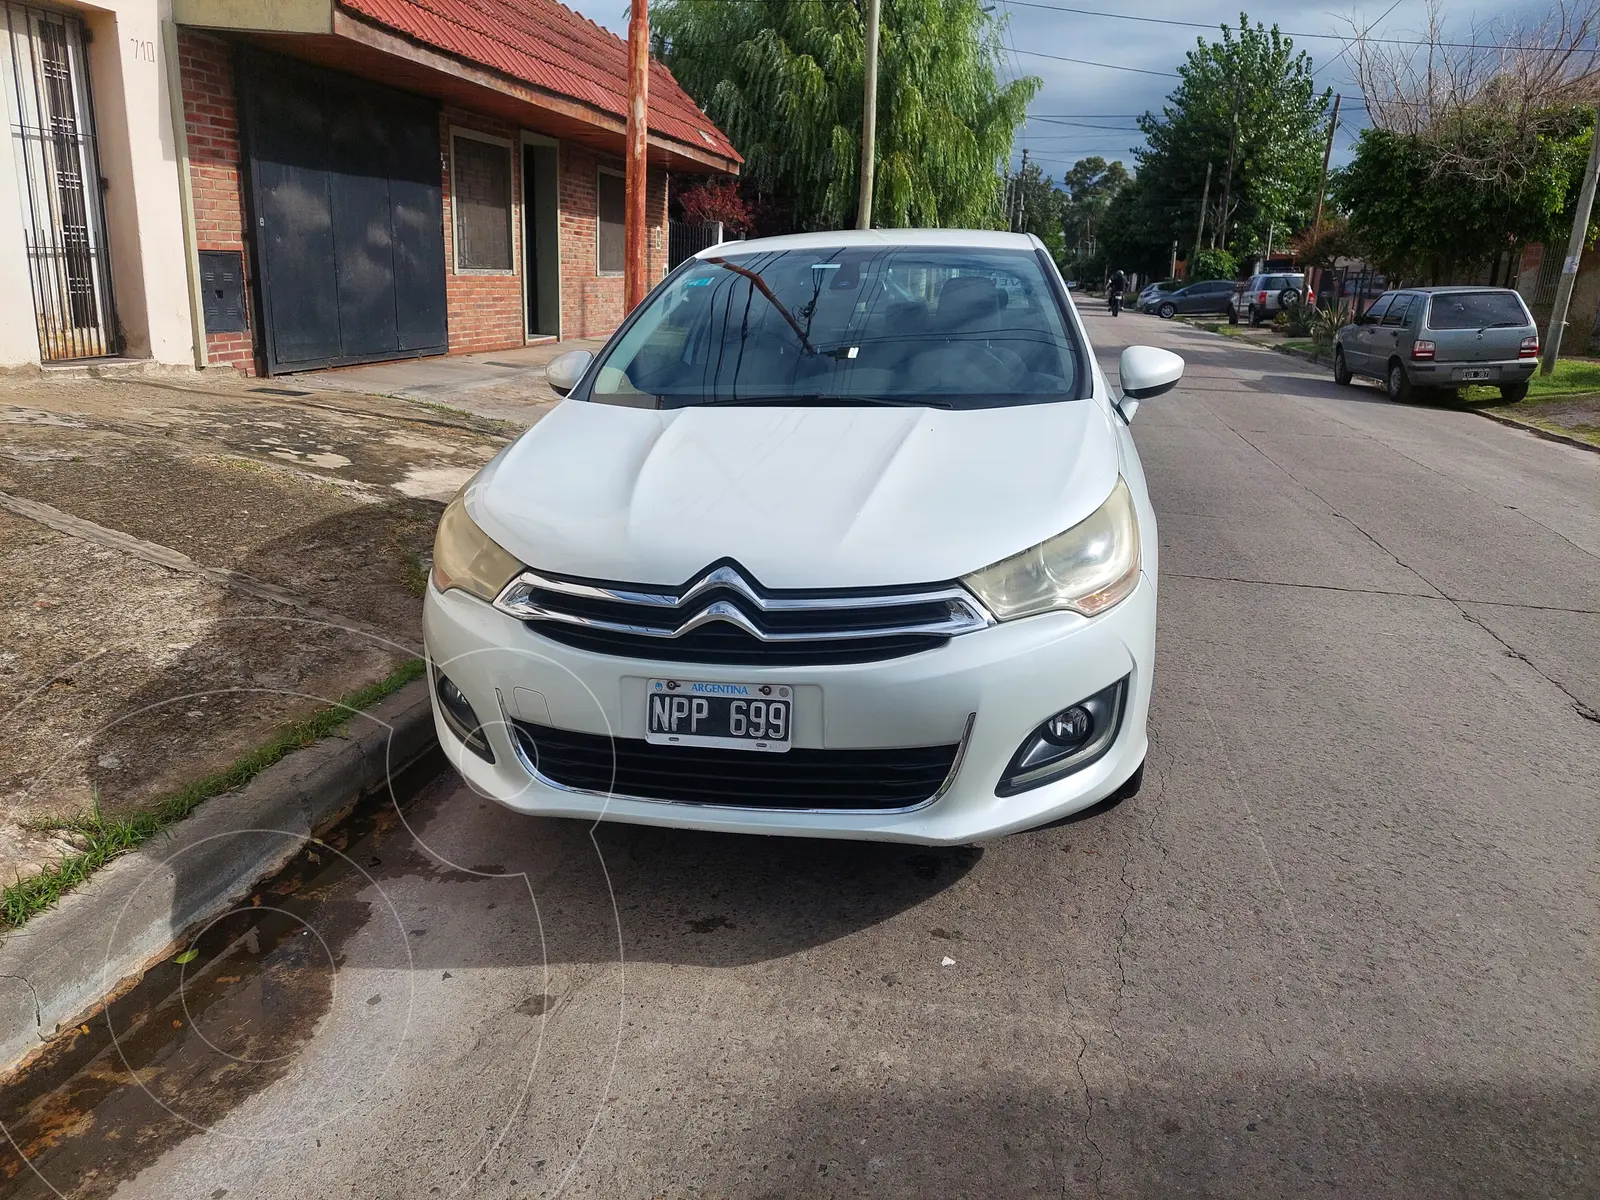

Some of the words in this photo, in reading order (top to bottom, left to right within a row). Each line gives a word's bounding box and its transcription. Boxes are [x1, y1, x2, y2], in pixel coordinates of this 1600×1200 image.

[130, 38, 155, 62] 710
[691, 683, 748, 695] ARGENTINA
[652, 696, 709, 732] NPP
[729, 700, 787, 739] 699
